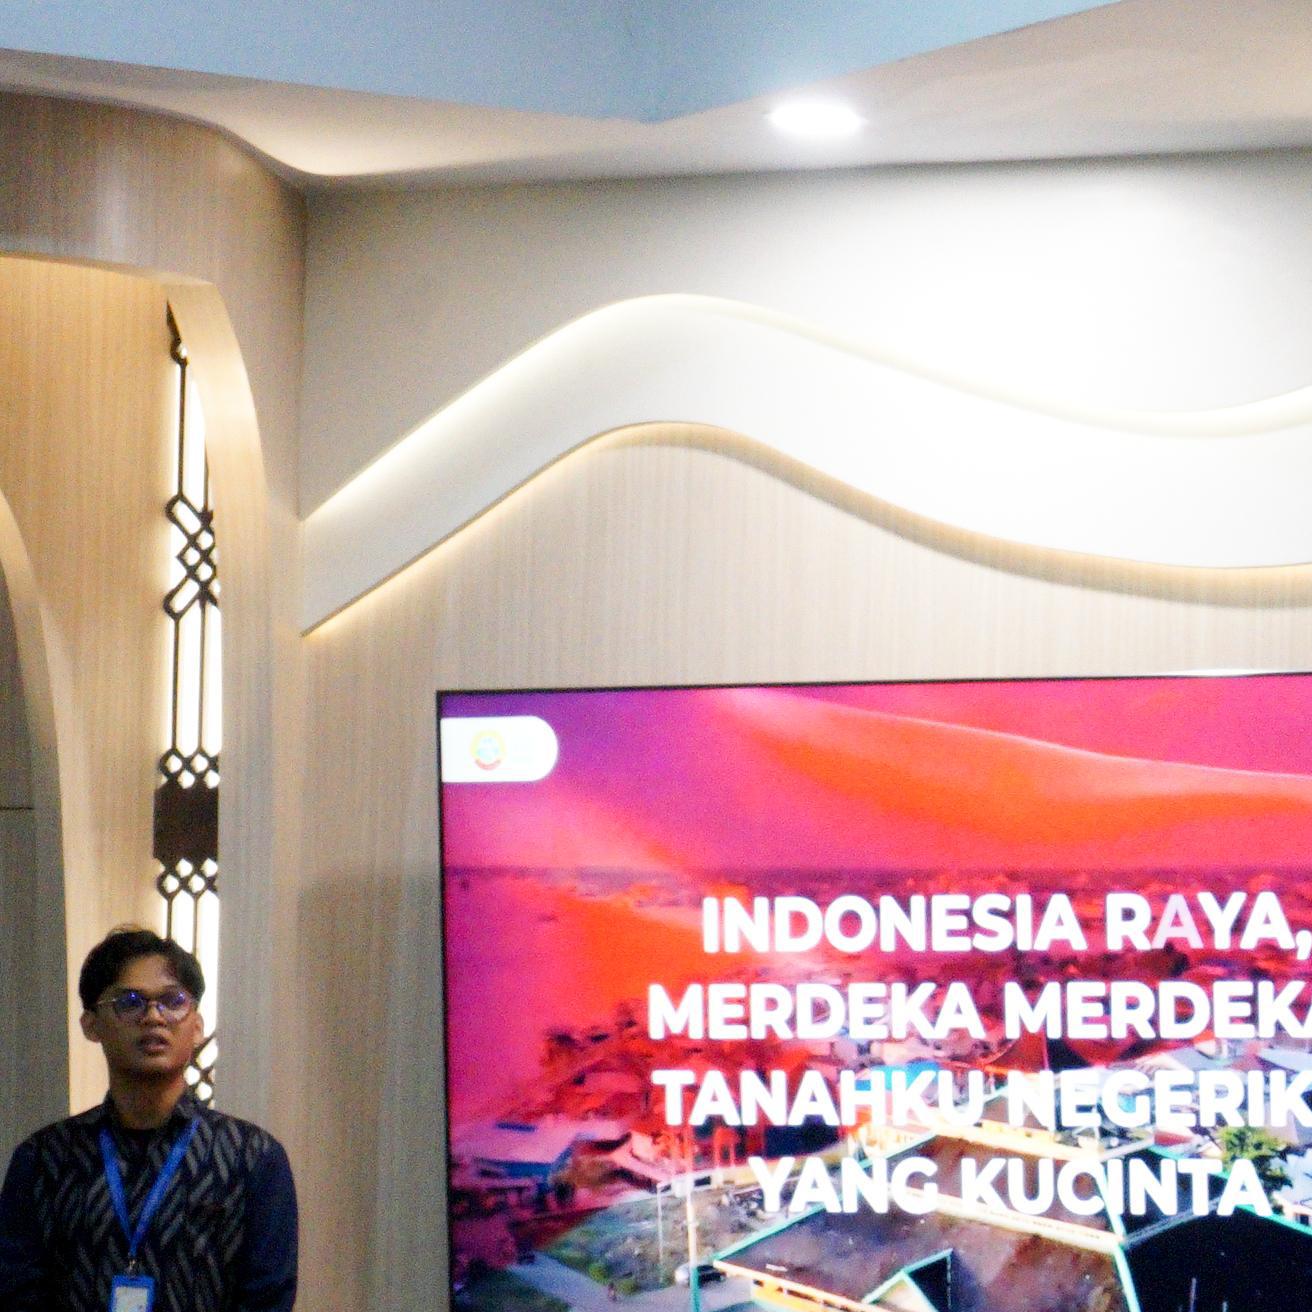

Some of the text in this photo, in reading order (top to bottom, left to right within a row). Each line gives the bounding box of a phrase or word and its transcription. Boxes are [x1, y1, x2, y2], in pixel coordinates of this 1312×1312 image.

[703, 892, 1312, 960] INDONESIA RAYA,
[648, 981, 985, 1040] MERDEKA
[653, 1069, 984, 1127] TANAHKU
[747, 1157, 1273, 1217] YANG KUCINTA
